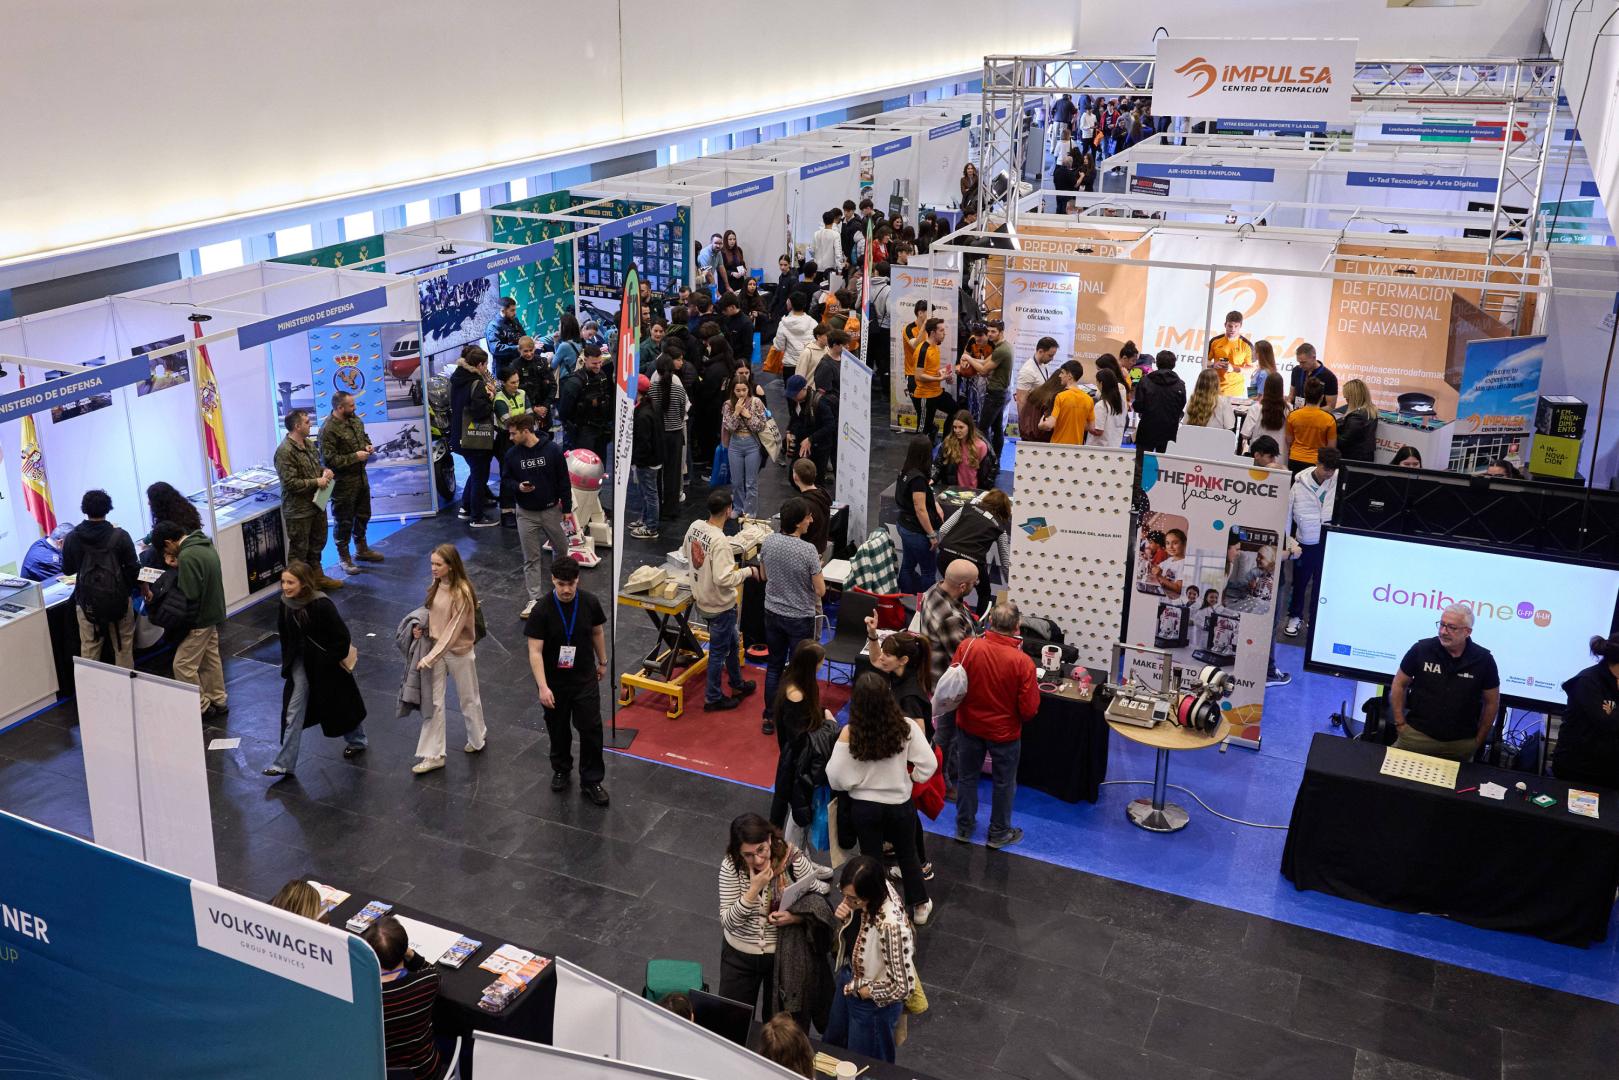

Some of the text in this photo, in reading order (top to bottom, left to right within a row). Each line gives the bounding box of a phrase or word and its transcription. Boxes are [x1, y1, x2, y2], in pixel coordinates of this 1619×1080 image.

[1274, 84, 1329, 94] FORMACIÓN
[1391, 178, 1428, 187] Tecnología
[1454, 180, 1478, 188] Digital
[486, 254, 521, 270] GUARDIA CIVIL
[1023, 258, 1068, 272] SER UN
[1030, 280, 1073, 291] IMPULSA
[1343, 282, 1362, 295] DE
[278, 314, 316, 331] MINISTERIO
[326, 303, 354, 317] DEFENSA
[1340, 300, 1442, 321] PROFESIONAL
[1338, 319, 1428, 339] DE NAVARRA
[45, 390, 58, 400] DE
[60, 377, 103, 396] DEFENSA
[1181, 484, 1242, 515] factory
[1133, 658, 1157, 669] MAKE
[1186, 668, 1197, 677] TO
[1423, 662, 1442, 674] NA
[0, 903, 50, 944] NER
[209, 908, 334, 965] VOLKSWAGEN
[240, 940, 305, 969] GROUP SERVICES
